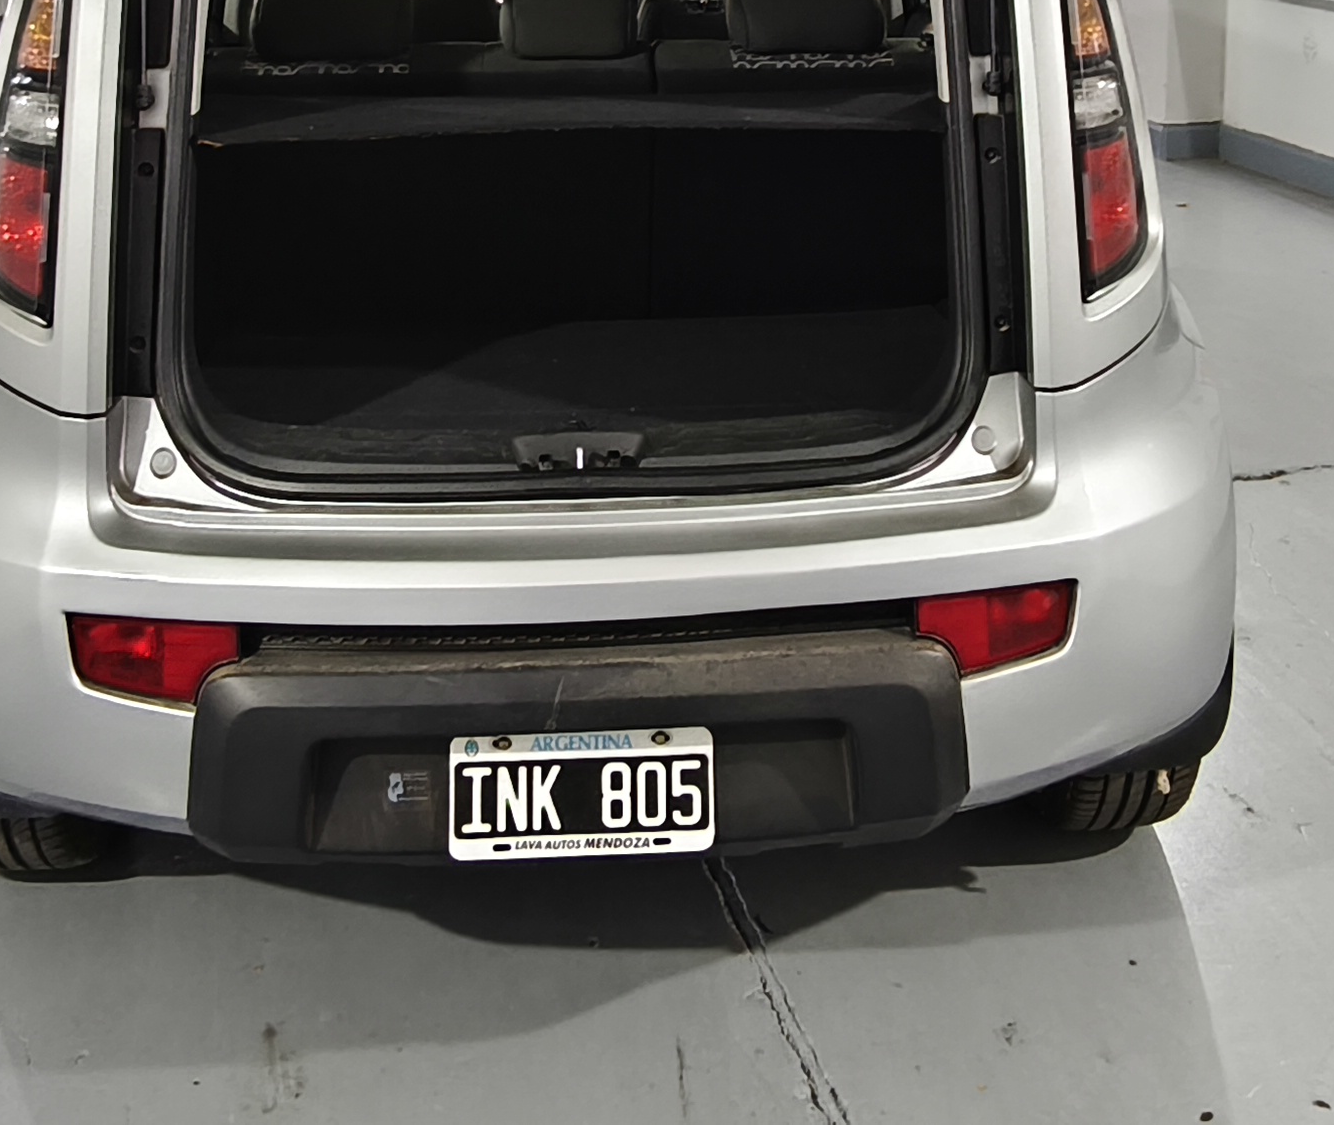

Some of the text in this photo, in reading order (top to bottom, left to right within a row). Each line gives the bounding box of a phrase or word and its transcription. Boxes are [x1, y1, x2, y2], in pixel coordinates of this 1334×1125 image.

[530, 733, 634, 752] ARGENTINA
[461, 764, 562, 834] INK
[600, 759, 703, 829] 805
[514, 836, 651, 851] LAVA AUTOS MENDOZA
